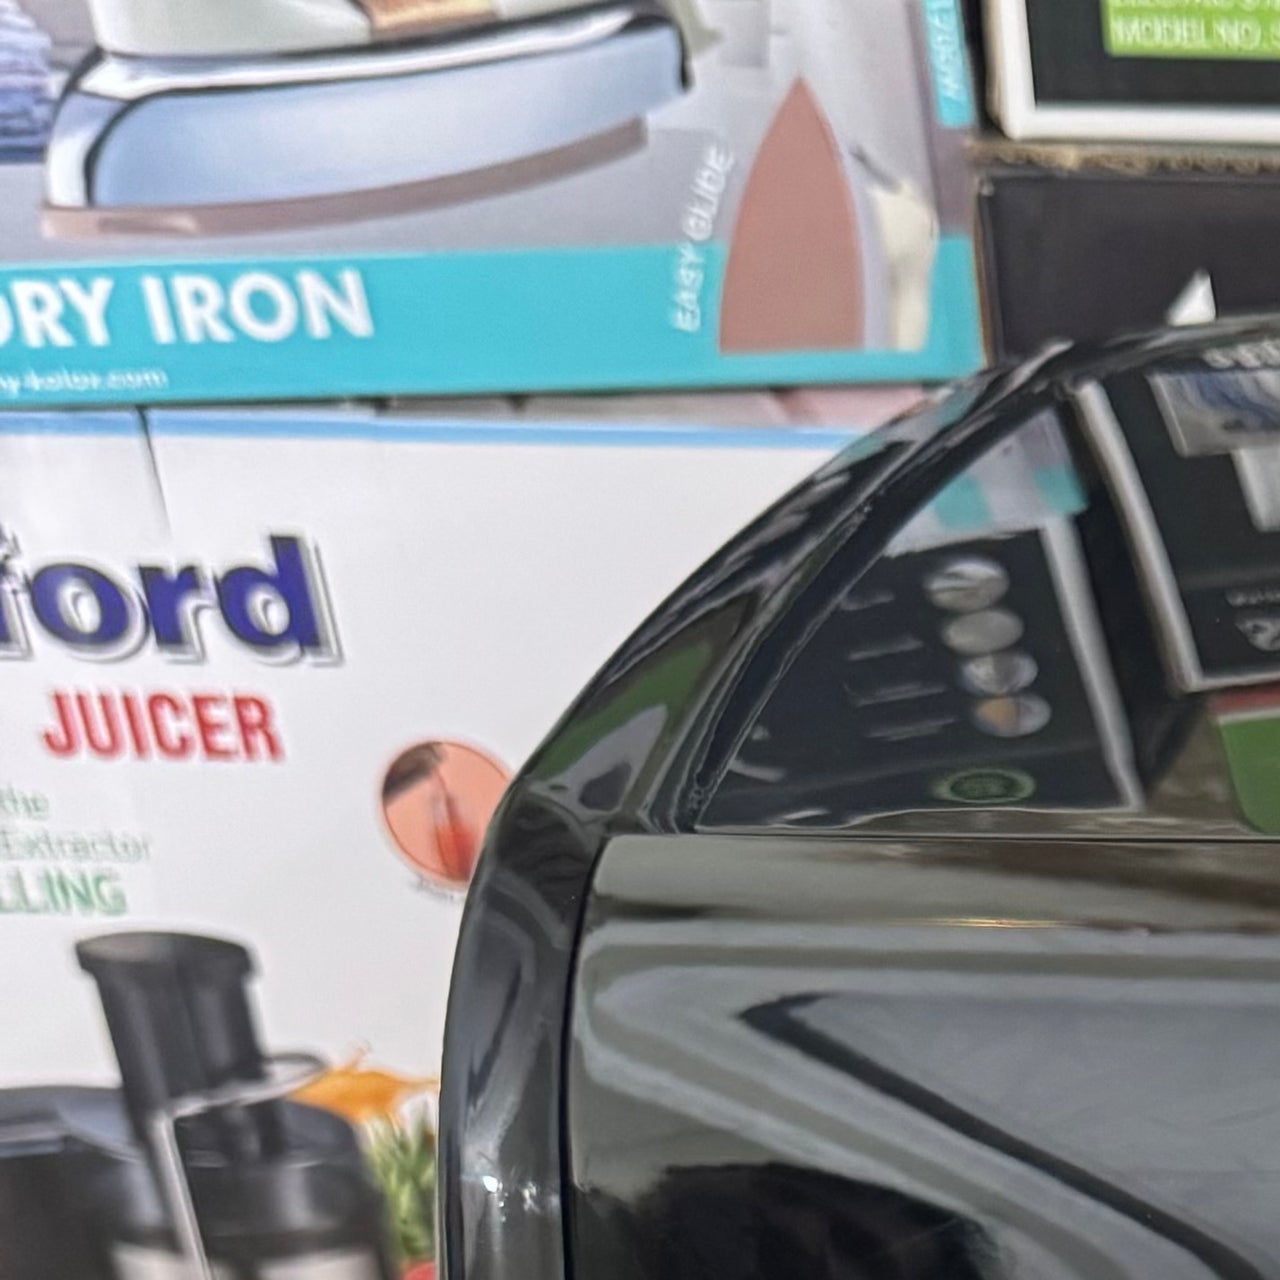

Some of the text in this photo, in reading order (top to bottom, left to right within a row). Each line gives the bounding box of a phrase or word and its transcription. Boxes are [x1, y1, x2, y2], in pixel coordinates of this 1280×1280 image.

[0, 266, 375, 350] RY IRON
[42, 690, 285, 762] JUICER
